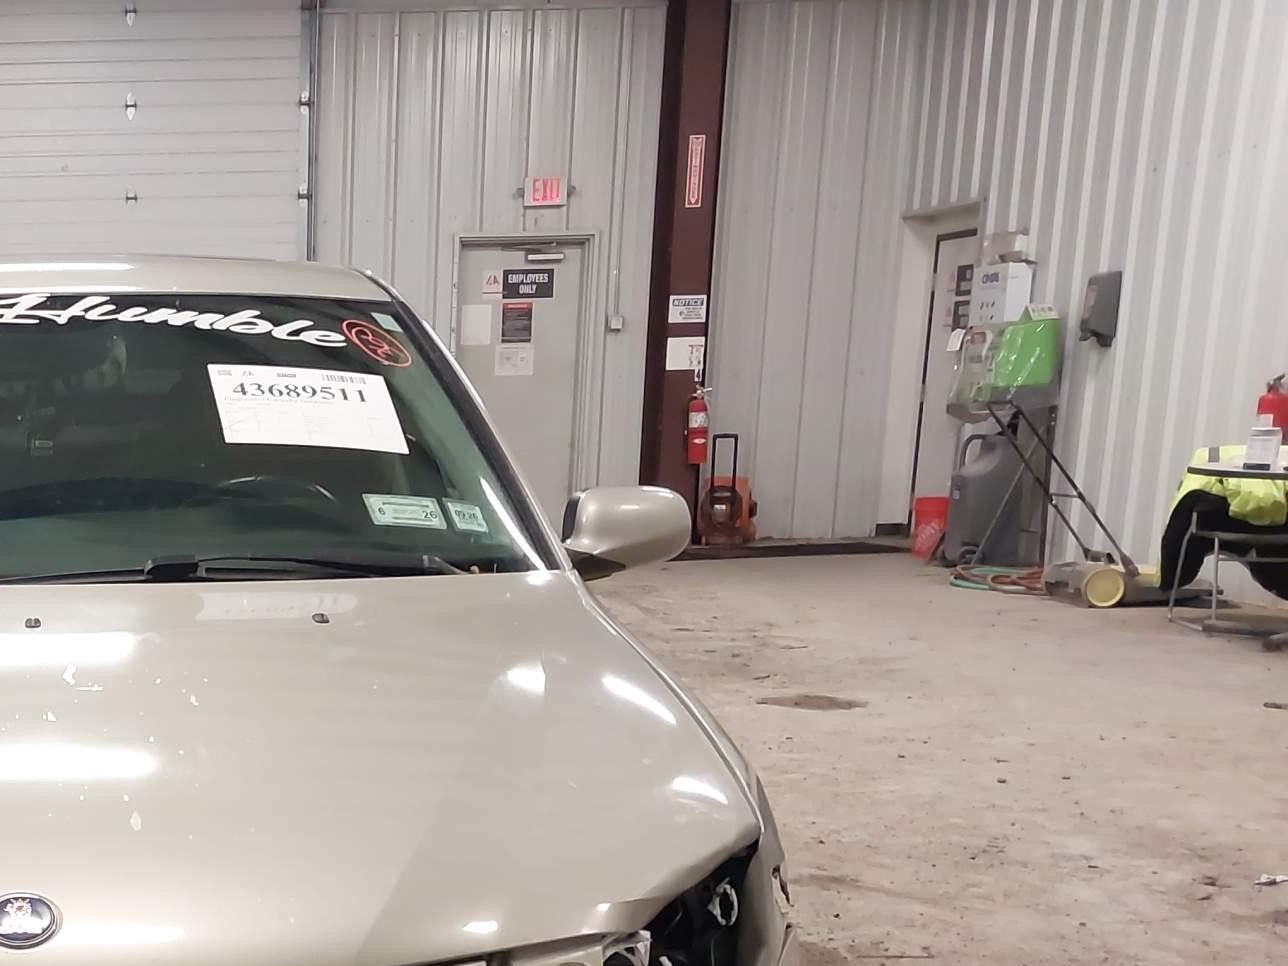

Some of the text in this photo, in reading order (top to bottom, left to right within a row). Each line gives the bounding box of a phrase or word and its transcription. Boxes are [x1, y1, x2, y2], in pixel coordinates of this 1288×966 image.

[532, 178, 560, 201] EXIT
[508, 273, 549, 283] EMPLOYEES
[519, 284, 537, 294] ONLY
[673, 299, 704, 307] NOTICE
[233, 382, 367, 402] 43689511
